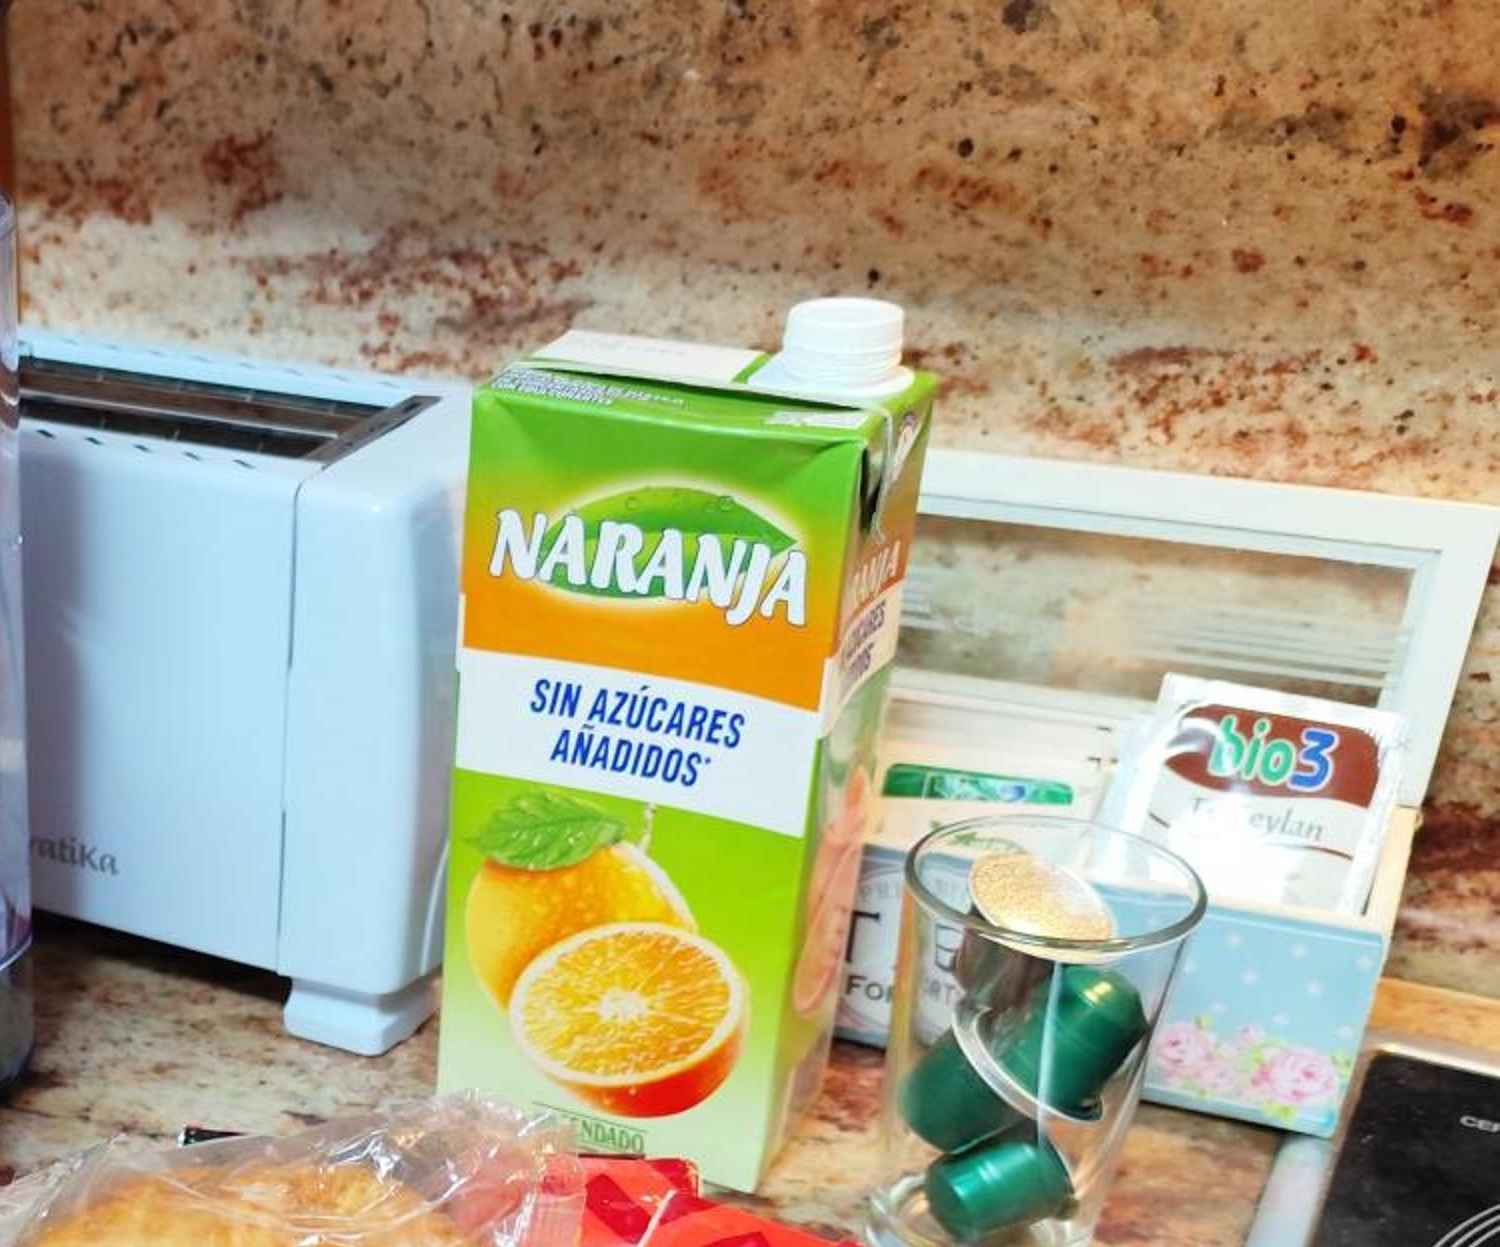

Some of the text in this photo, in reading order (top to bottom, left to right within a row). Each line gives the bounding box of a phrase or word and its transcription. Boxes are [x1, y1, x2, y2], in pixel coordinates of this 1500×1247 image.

[489, 508, 808, 627] NARANJA
[530, 678, 746, 749] SIN AZÚCARES
[1206, 714, 1340, 792] bio3
